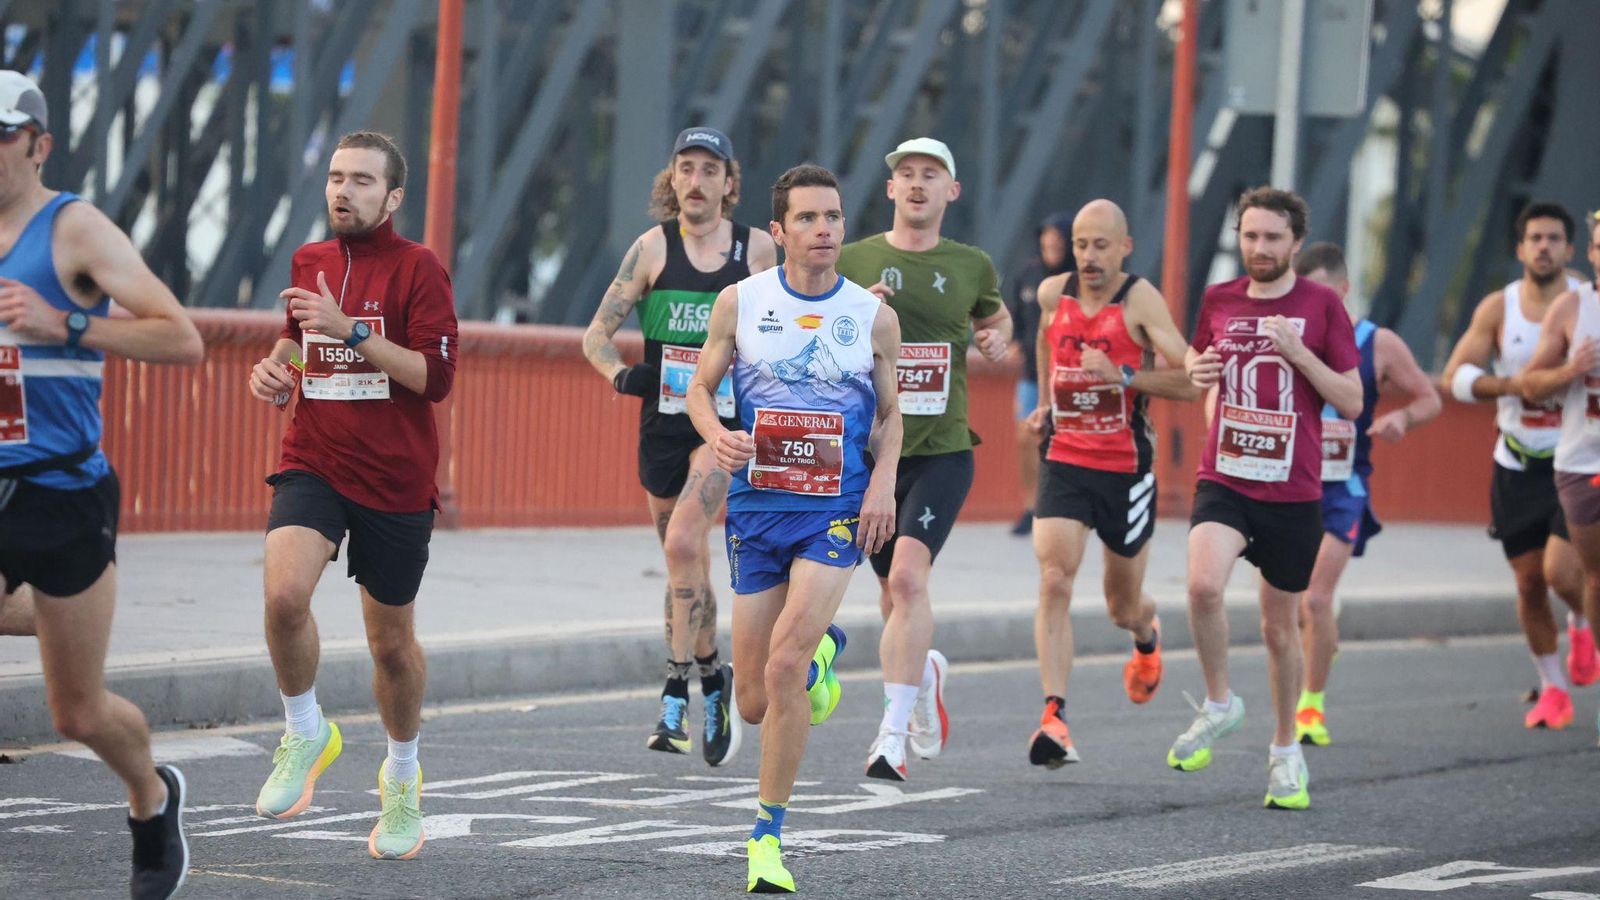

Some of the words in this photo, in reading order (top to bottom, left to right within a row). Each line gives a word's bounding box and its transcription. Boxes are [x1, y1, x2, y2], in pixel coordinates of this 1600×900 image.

[686, 132, 720, 146] HOKA
[1222, 354, 1294, 412] 10
[1072, 392, 1099, 405] 255
[778, 415, 837, 429] GENERALI
[1232, 431, 1276, 450] 12728
[781, 440, 815, 457] 750
